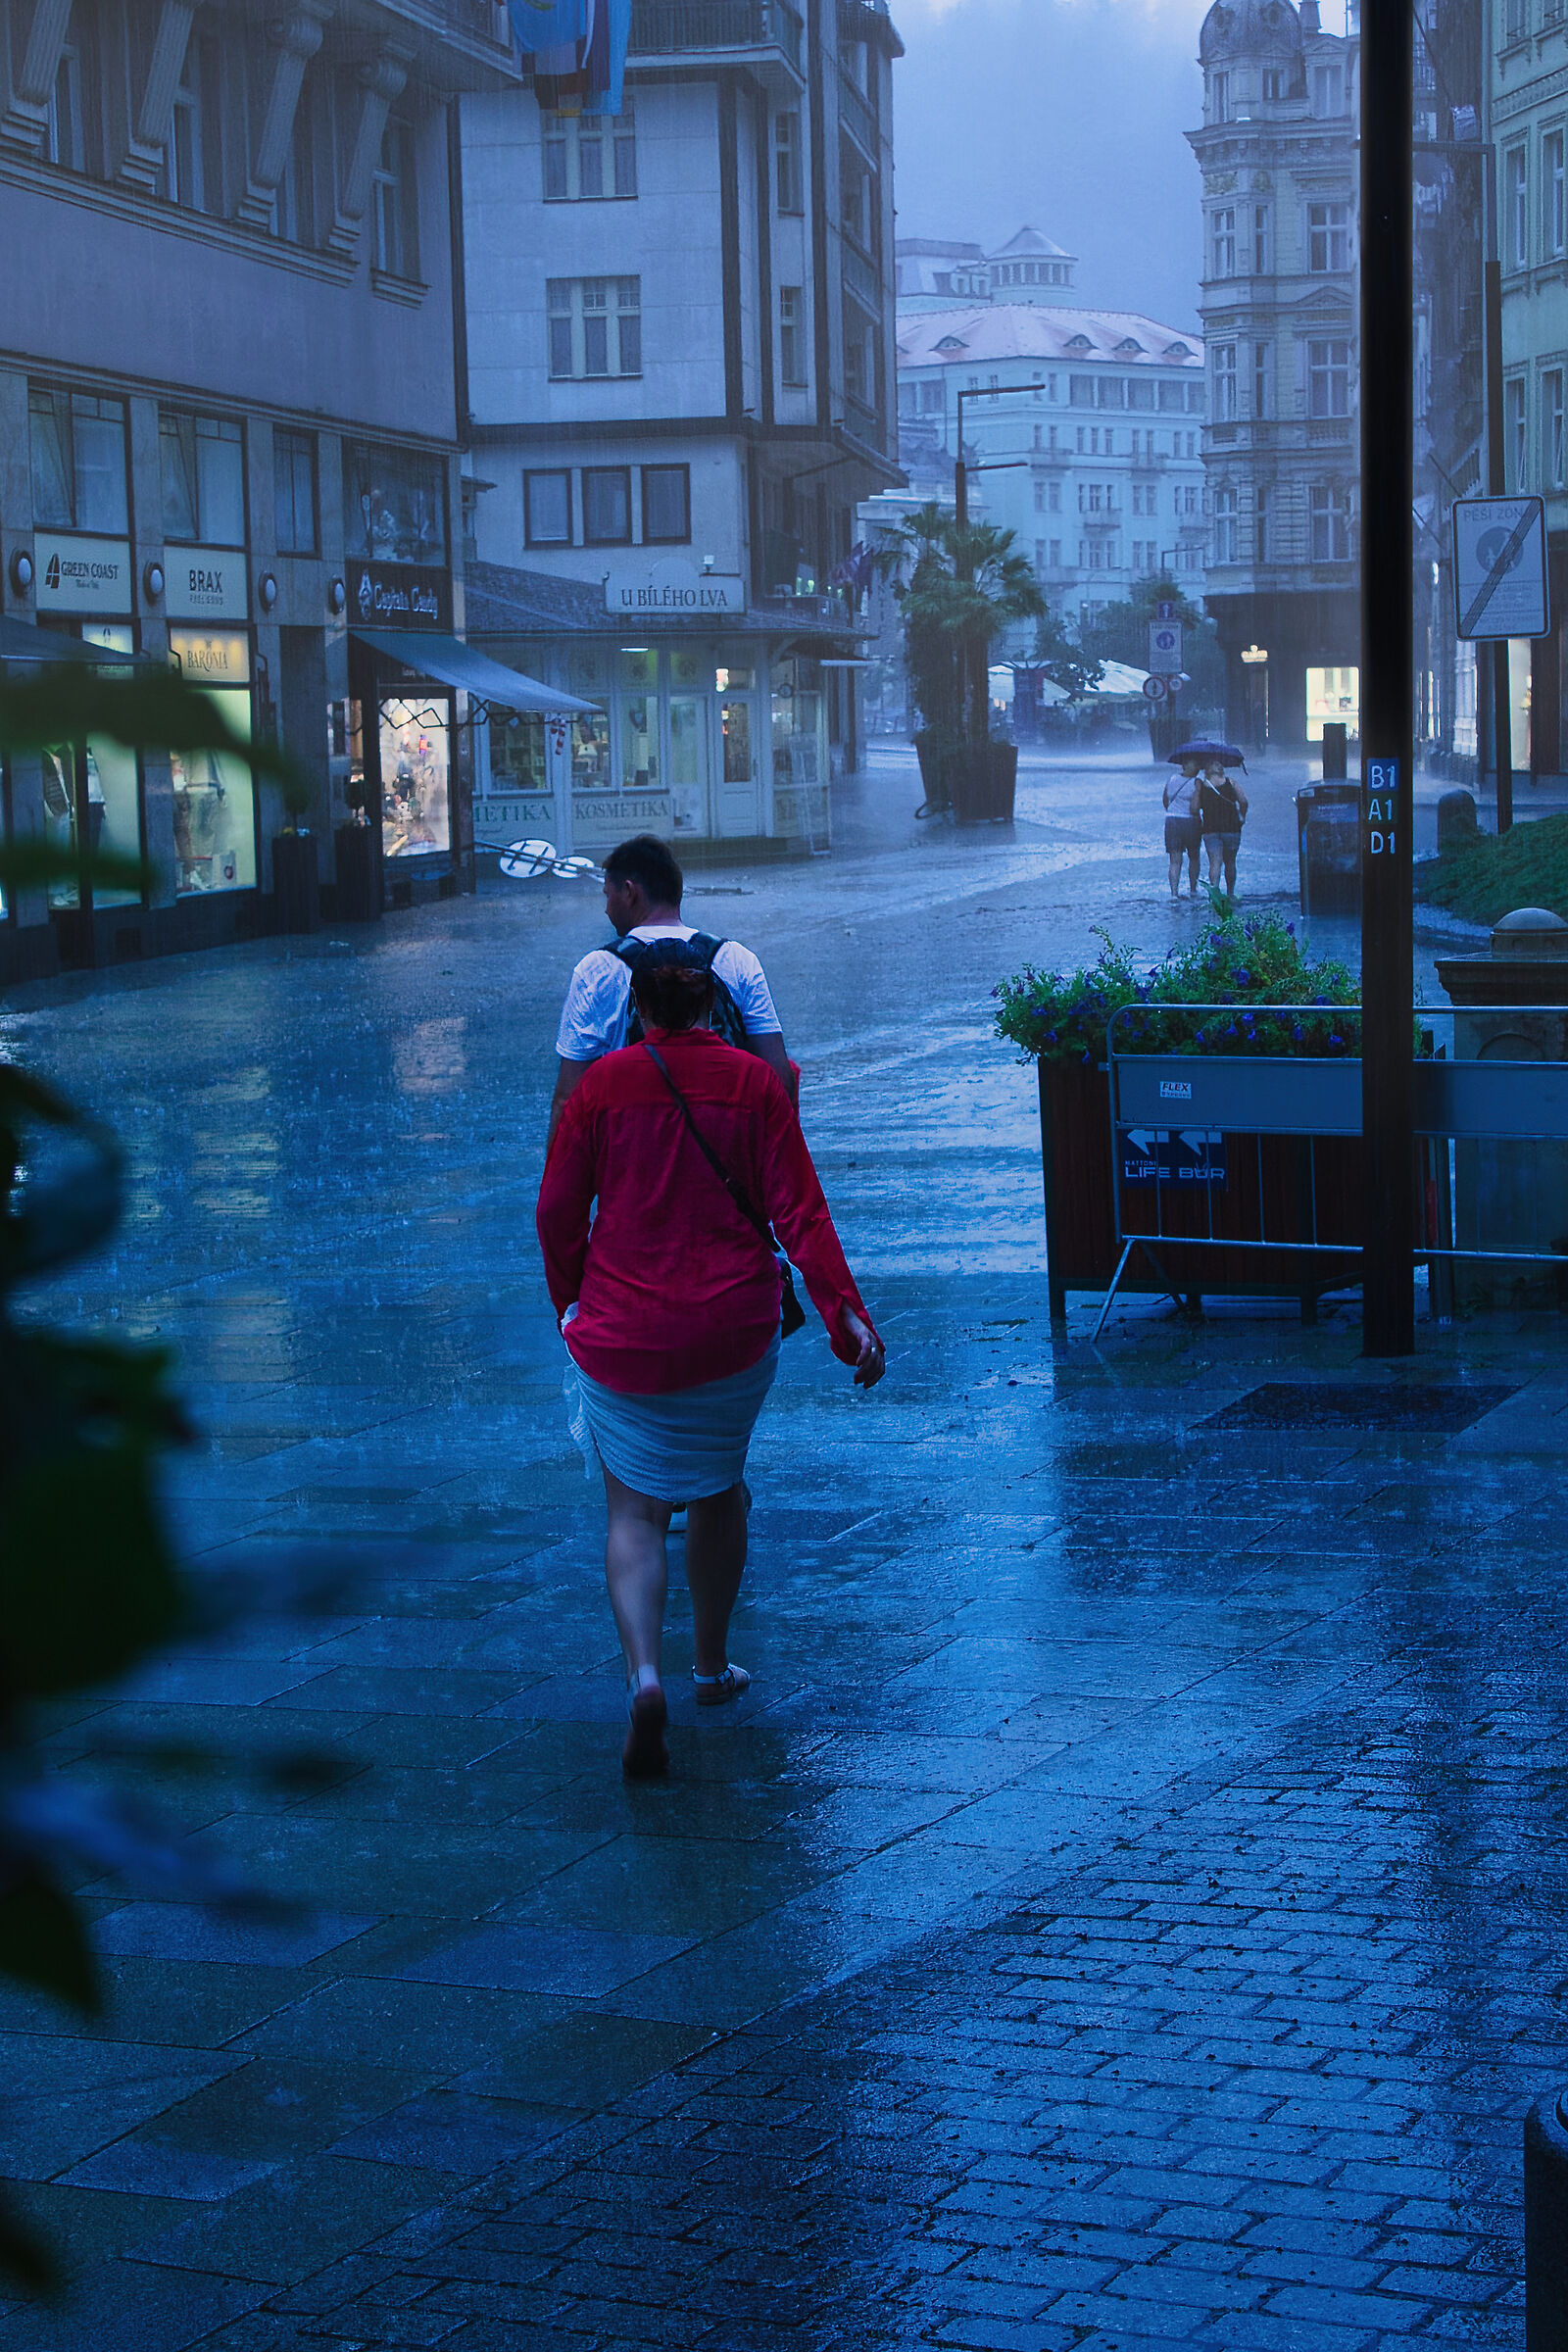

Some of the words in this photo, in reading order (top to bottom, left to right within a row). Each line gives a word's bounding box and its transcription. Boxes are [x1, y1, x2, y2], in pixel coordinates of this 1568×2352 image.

[61, 561, 90, 577] GREEN
[91, 563, 119, 580] COAST
[189, 569, 222, 594] BRAX
[621, 589, 632, 606] U
[637, 585, 697, 607] BÍLÉHO
[700, 589, 728, 607] LVA
[1371, 765, 1396, 789] B1
[574, 799, 669, 820] KOSMETIKA
[1367, 799, 1393, 821] A1
[1371, 831, 1396, 855] D1
[1162, 1082, 1189, 1092] FLEX
[1125, 1166, 1171, 1179] LIFE
